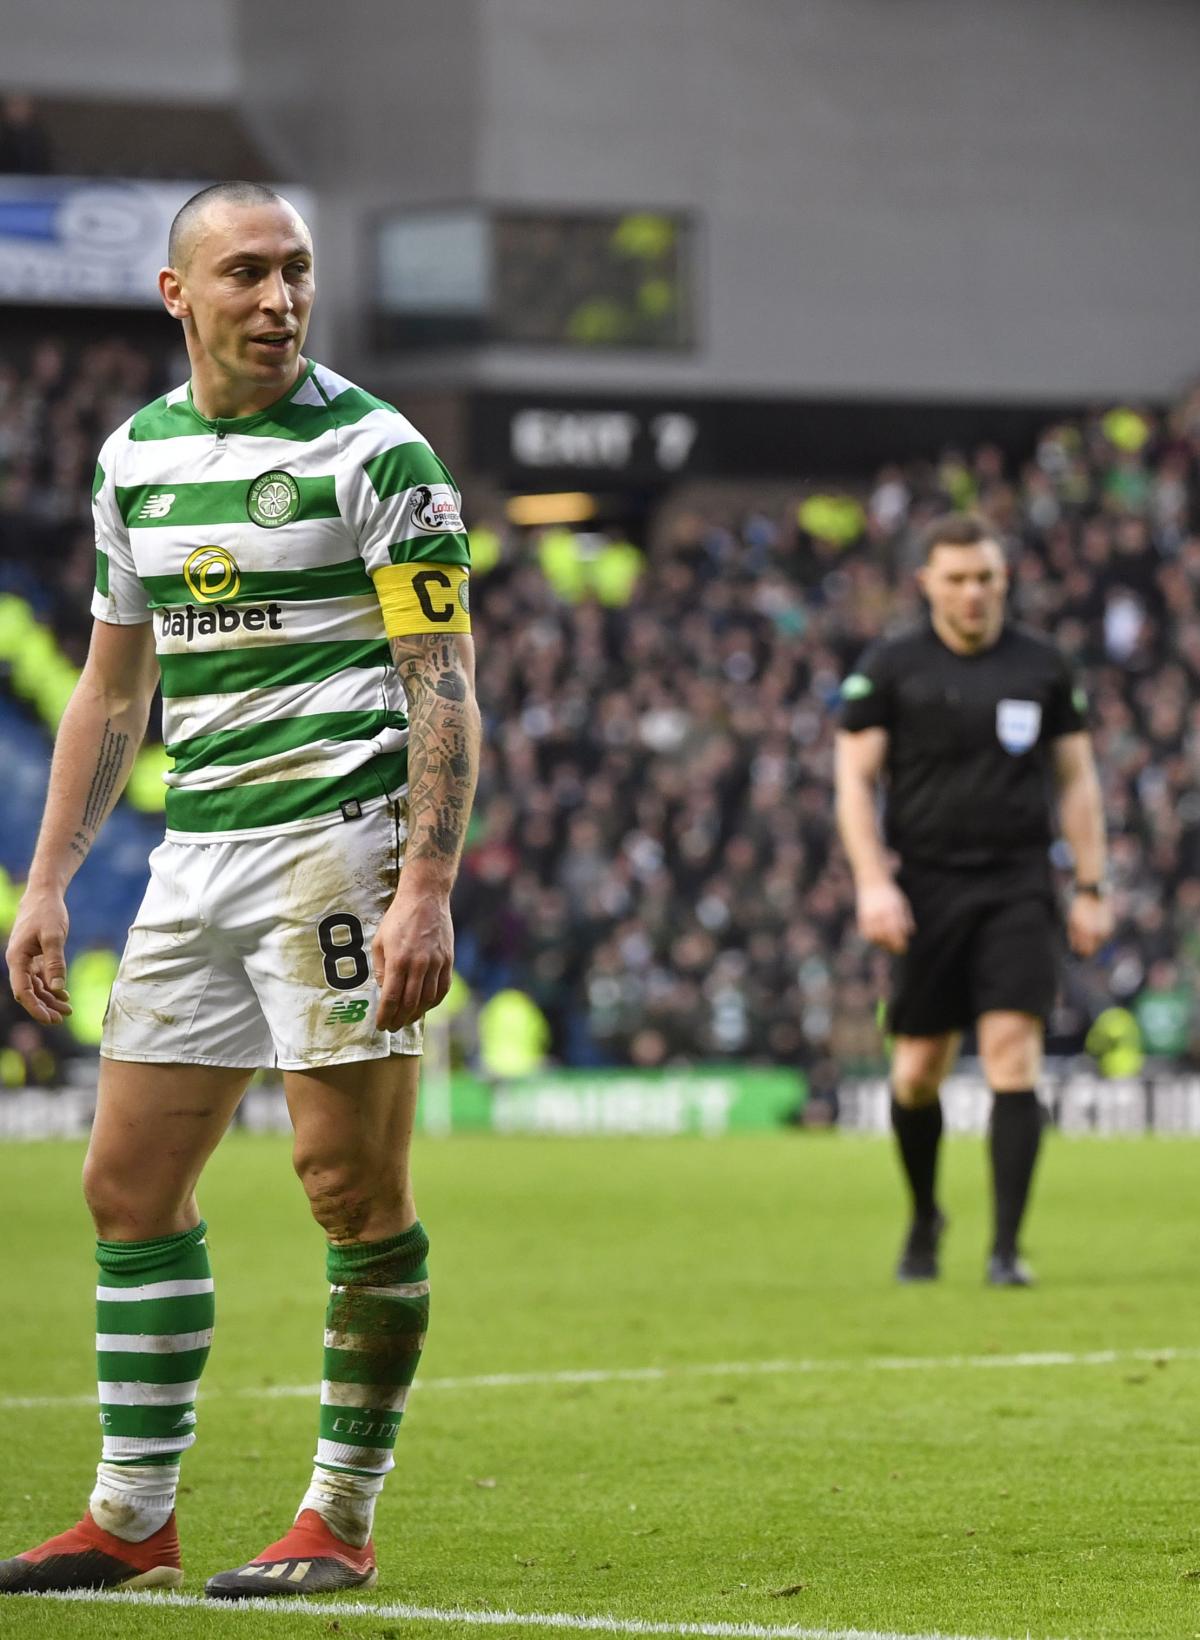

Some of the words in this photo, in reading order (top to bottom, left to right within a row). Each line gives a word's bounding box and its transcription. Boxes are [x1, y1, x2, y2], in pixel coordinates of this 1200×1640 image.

[511, 409, 638, 469] EXIT
[650, 412, 697, 471] 7
[411, 570, 454, 622] C
[318, 912, 369, 991] 8
